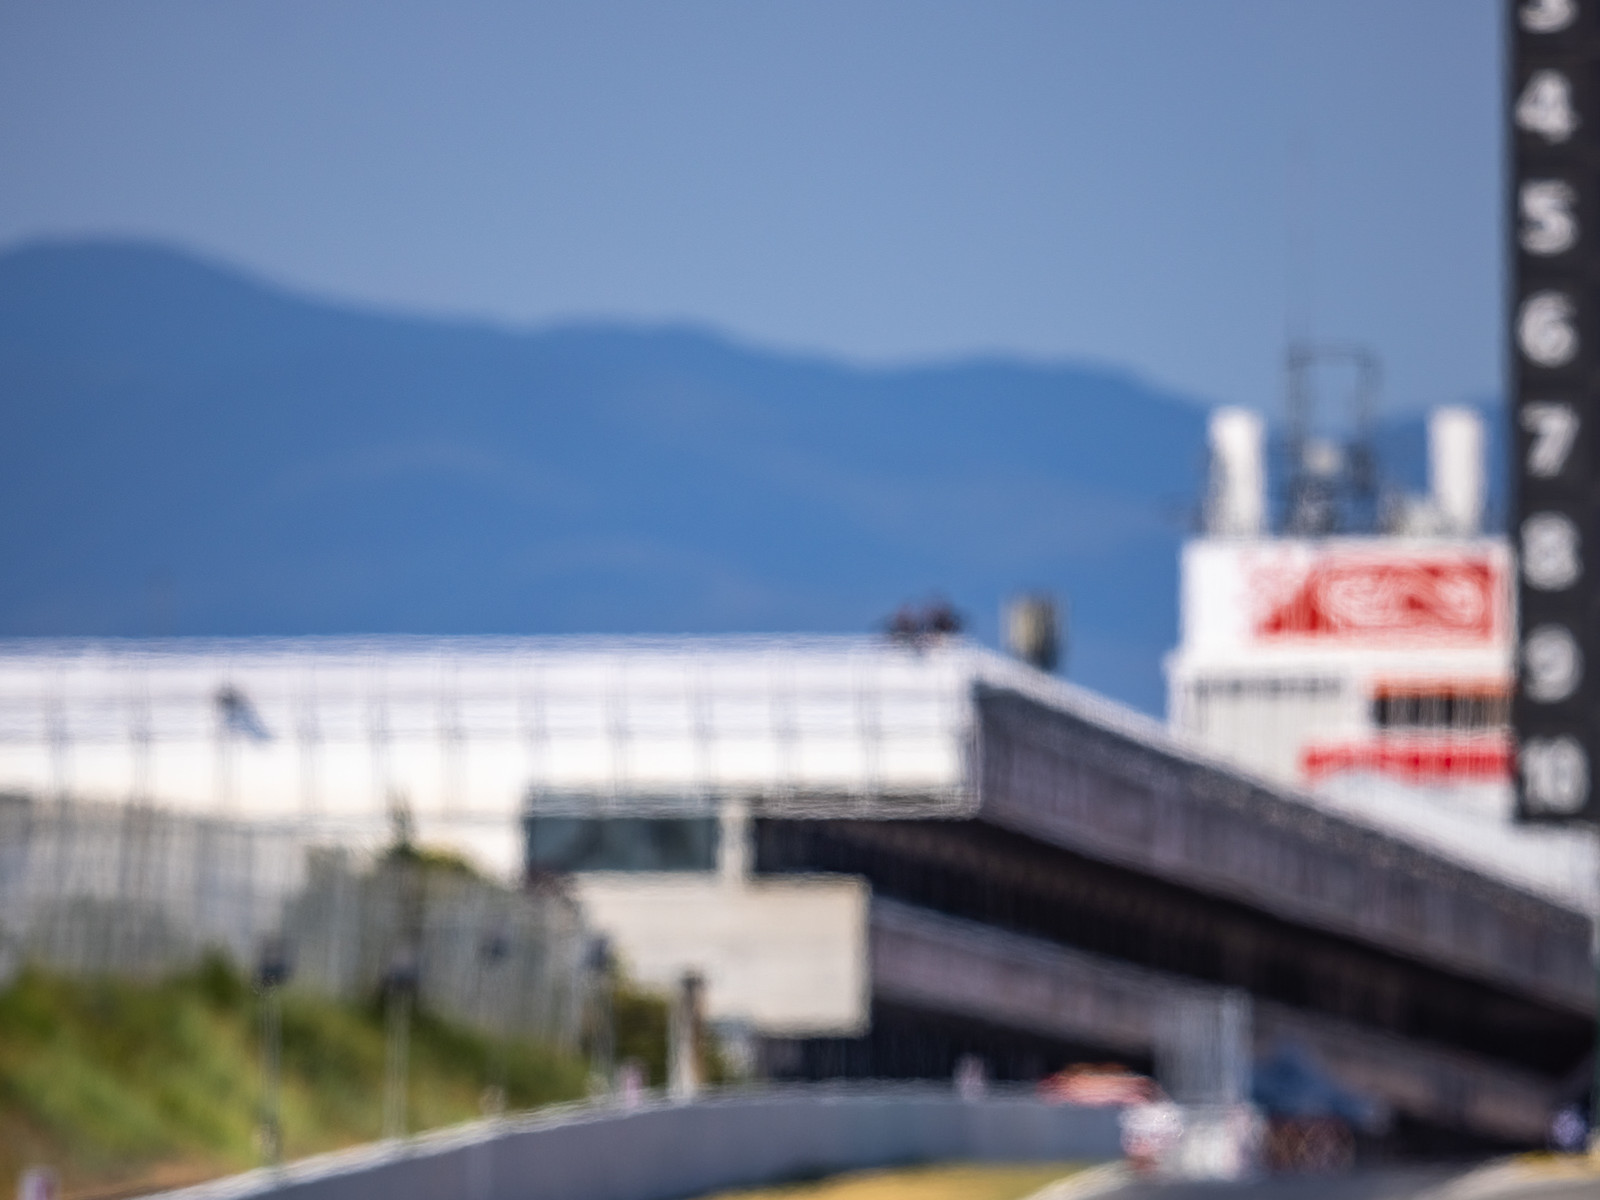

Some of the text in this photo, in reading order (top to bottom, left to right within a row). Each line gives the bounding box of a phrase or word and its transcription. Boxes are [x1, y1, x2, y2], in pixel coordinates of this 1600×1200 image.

[1516, 72, 1580, 142] 4
[1519, 180, 1575, 253] 5
[1517, 292, 1576, 366] 6
[1520, 404, 1578, 477] 7
[1518, 514, 1578, 590] 8
[1519, 628, 1580, 702] 9
[1520, 738, 1587, 812] 10
